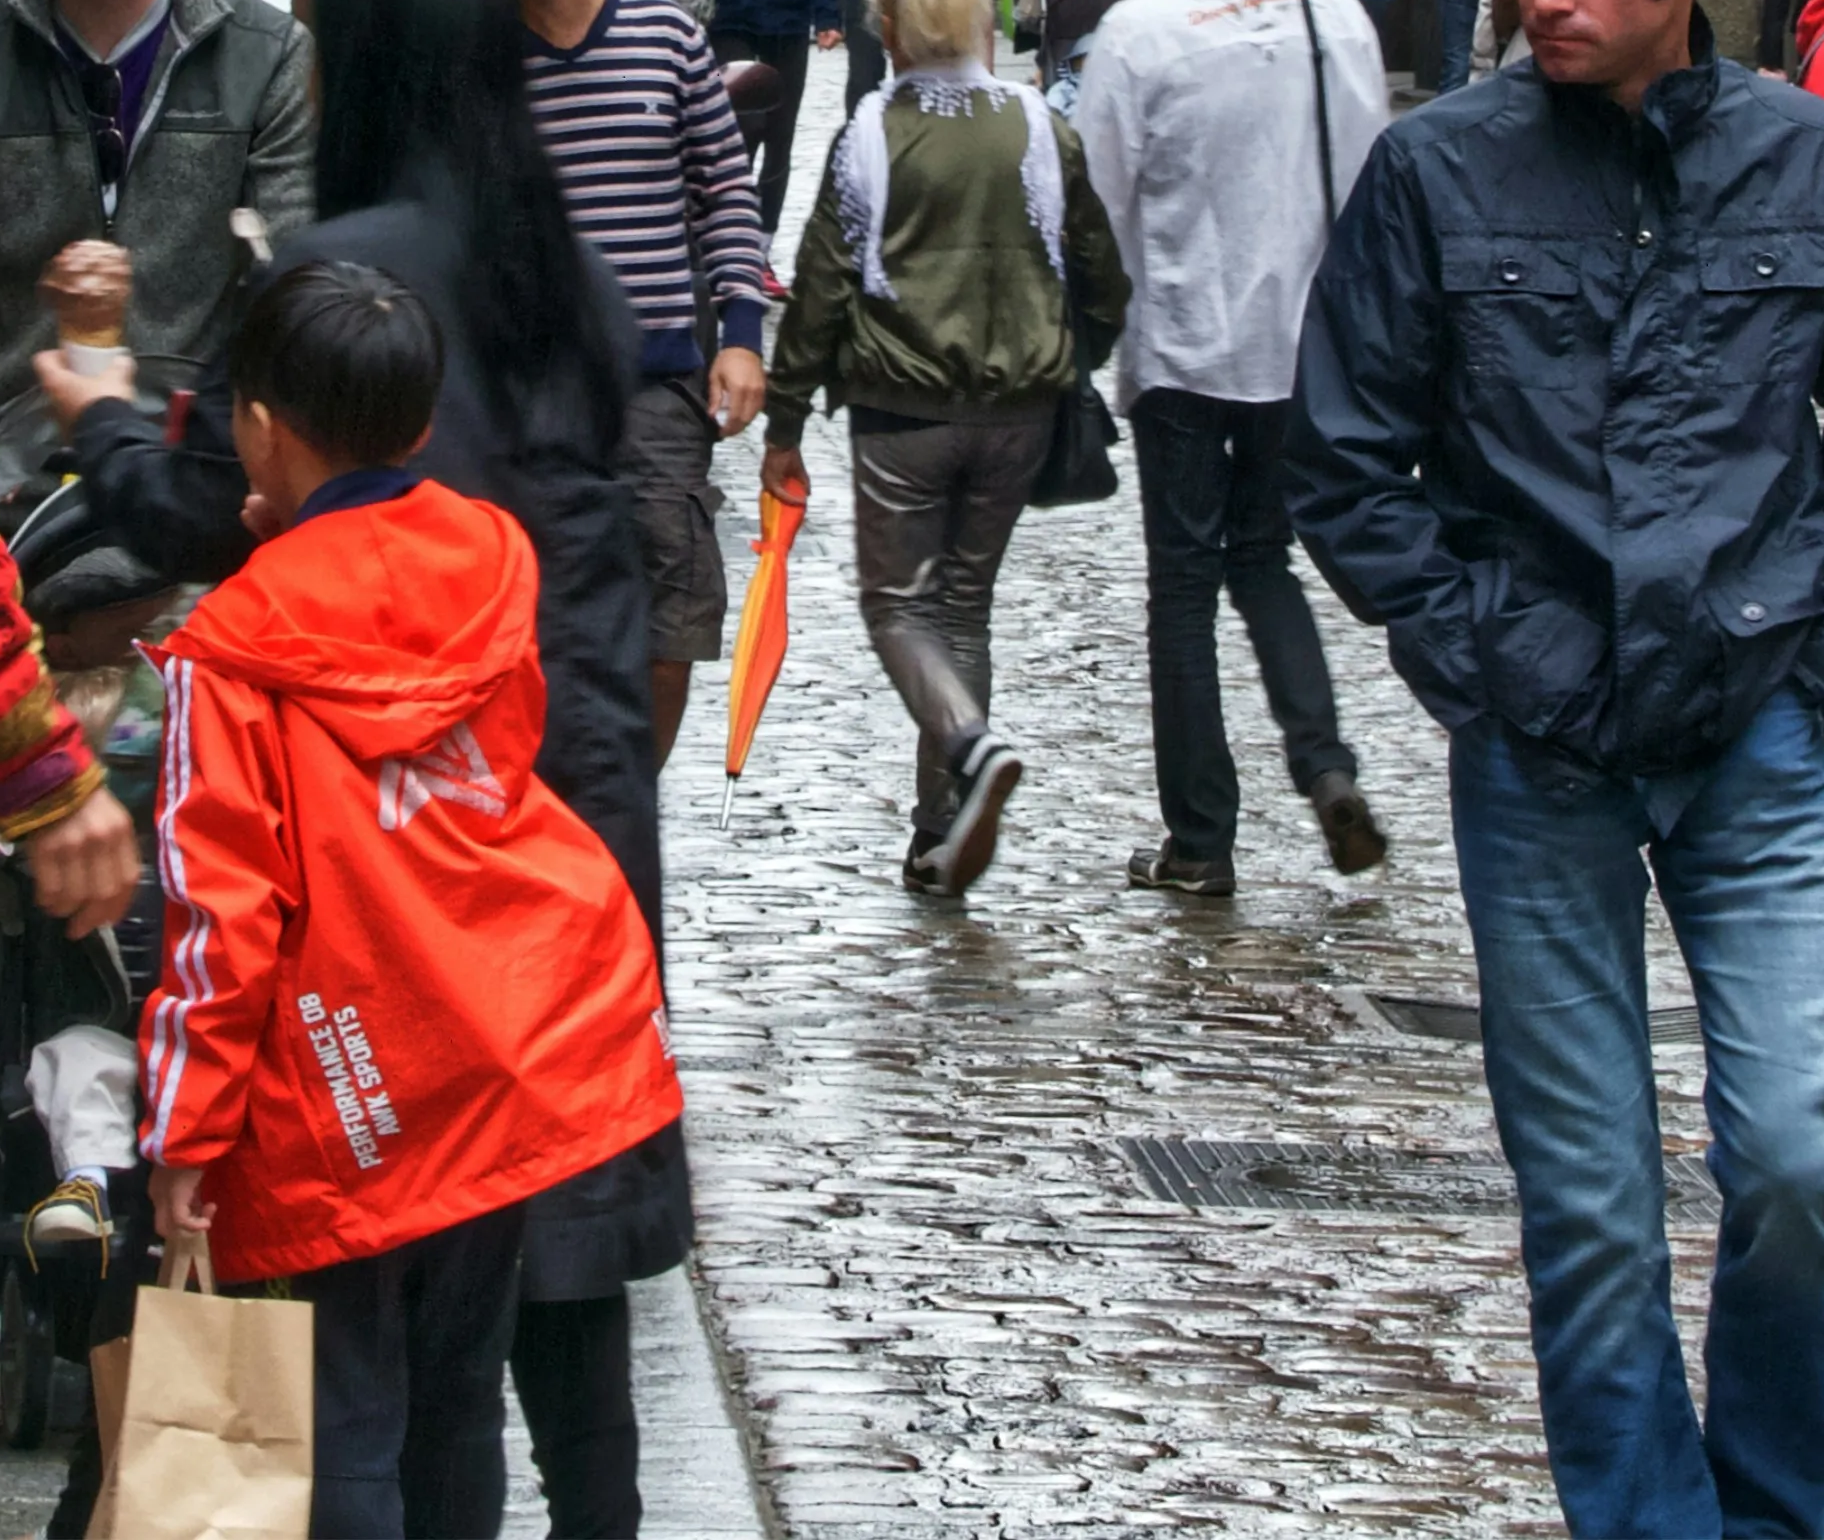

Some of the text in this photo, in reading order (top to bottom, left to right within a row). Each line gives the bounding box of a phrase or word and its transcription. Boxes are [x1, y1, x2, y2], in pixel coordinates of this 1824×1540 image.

[308, 1024, 384, 1170] PERFORMANCE
[332, 1005, 402, 1136] AWK SPORTS
